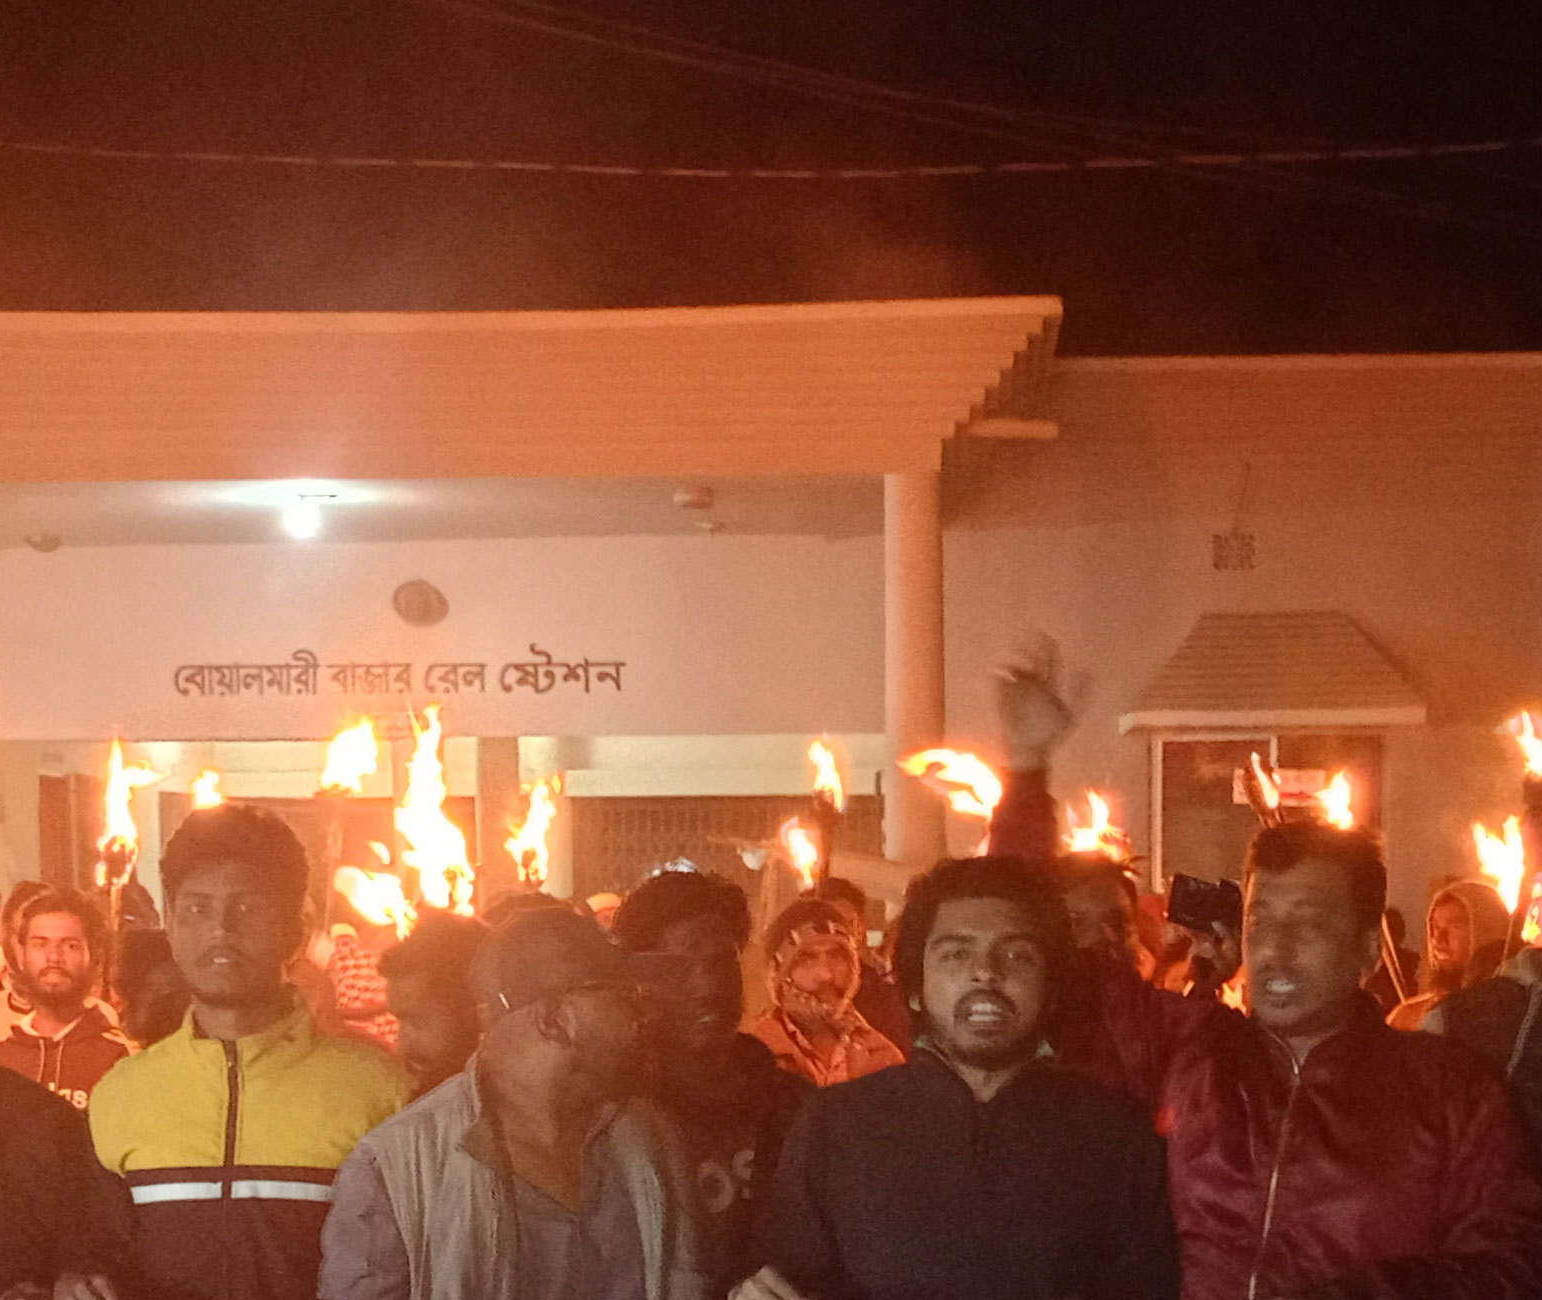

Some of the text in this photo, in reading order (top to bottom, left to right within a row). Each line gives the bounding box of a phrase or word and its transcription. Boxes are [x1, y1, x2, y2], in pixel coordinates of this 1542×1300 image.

[174, 649, 319, 696] বোয়ালমারী
[327, 661, 412, 694] বাজার
[423, 662, 487, 694] রেল
